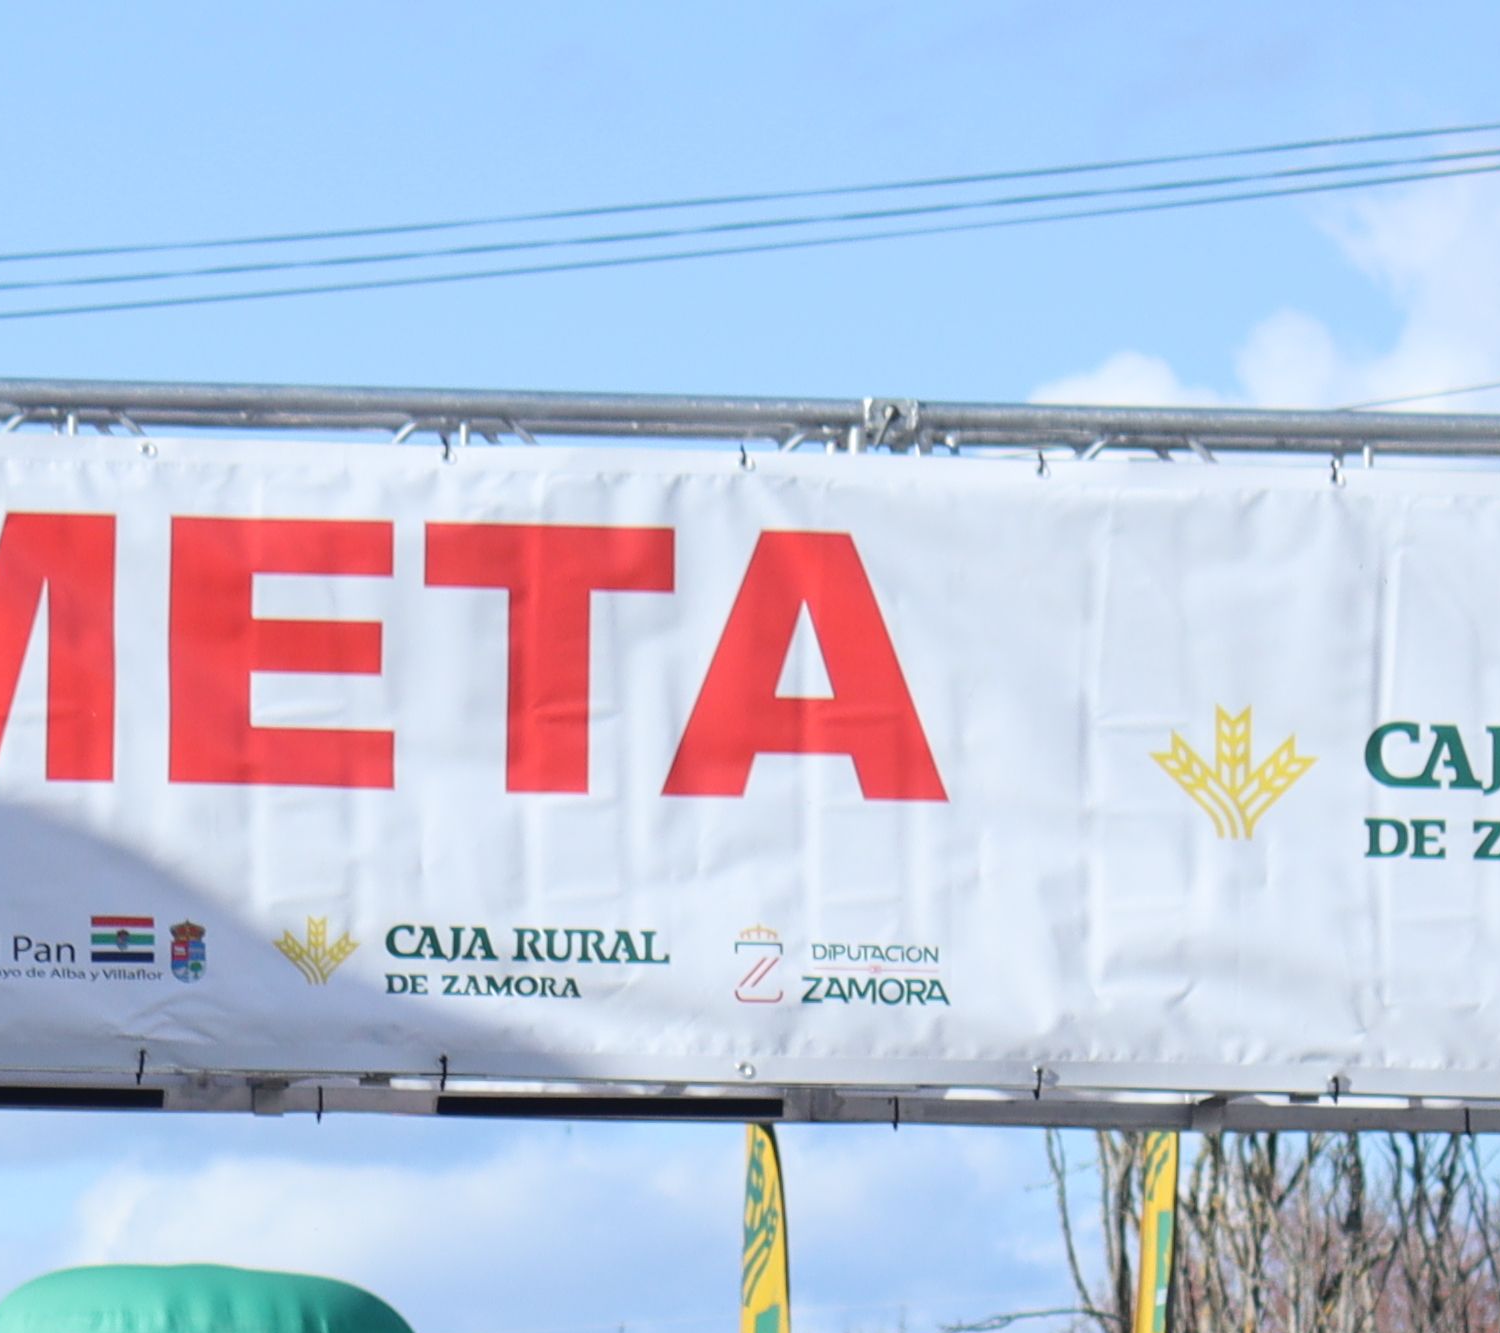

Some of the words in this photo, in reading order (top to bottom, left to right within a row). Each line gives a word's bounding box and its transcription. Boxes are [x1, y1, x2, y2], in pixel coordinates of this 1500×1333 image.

[1365, 818, 1445, 859] DE
[14, 936, 75, 962] Pan
[386, 925, 498, 961] CAJA
[512, 928, 669, 964] RURAL
[26, 967, 45, 977] de
[51, 968, 85, 979] Alba
[91, 970, 100, 982] y
[103, 968, 162, 980] Villaflor
[386, 974, 427, 994] DE
[442, 975, 581, 998] ZAMORA
[801, 977, 950, 1005] ZAMORA
